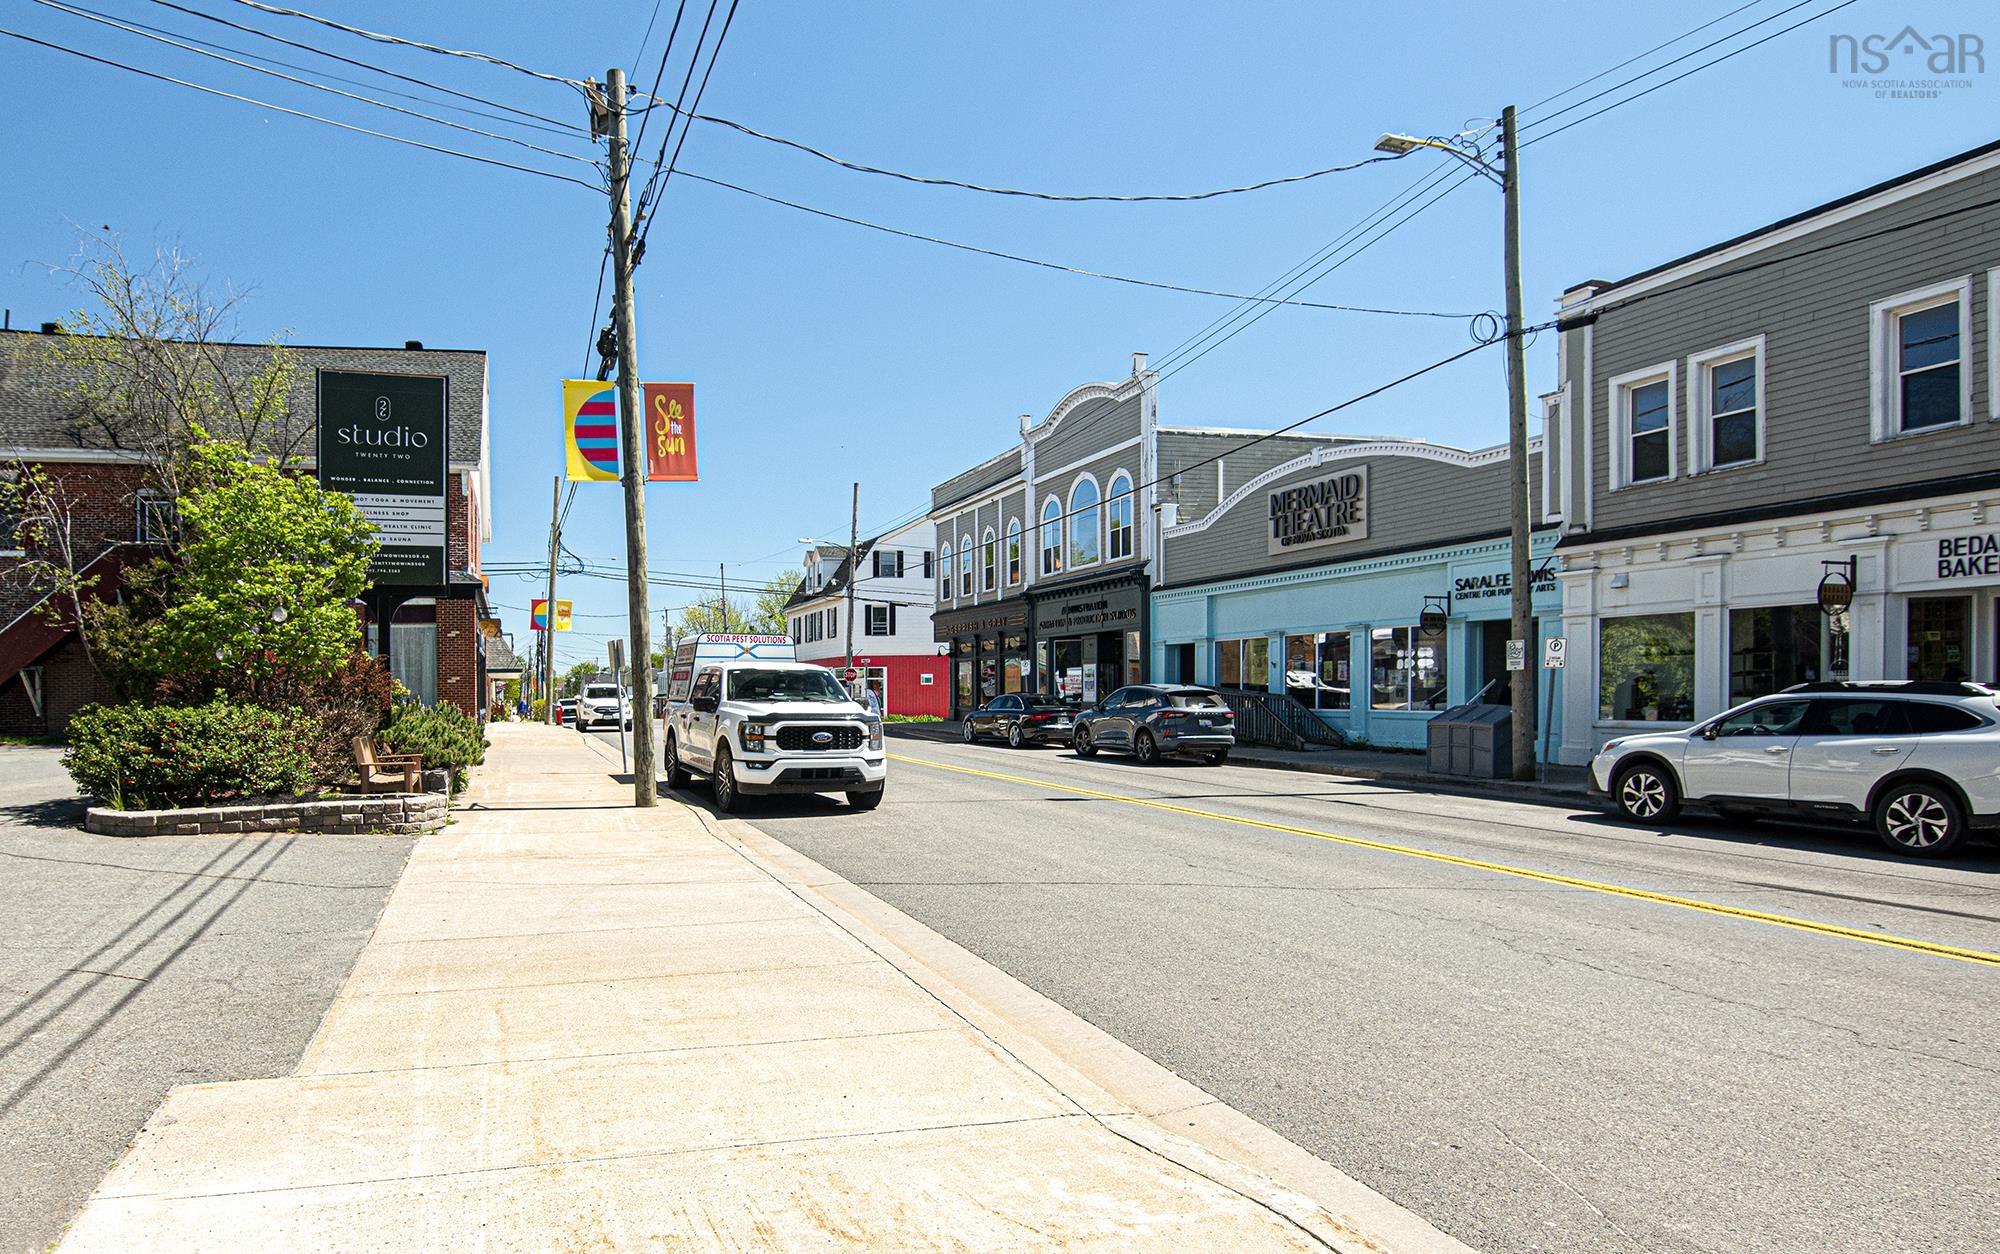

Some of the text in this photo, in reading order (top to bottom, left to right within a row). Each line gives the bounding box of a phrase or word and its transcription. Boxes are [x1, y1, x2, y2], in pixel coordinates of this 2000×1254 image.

[655, 394, 685, 435] See
[337, 424, 428, 448] studio
[670, 420, 682, 435] the
[1270, 474, 1360, 517] MERMAID
[1269, 500, 1364, 539] THEATRE
[1938, 534, 2000, 559] BEDA
[1938, 555, 2000, 579] BAKE
[1455, 573, 1511, 592] SARALEE
[1455, 590, 1481, 600] CENTRE
[1482, 588, 1497, 598] FOR
[1535, 583, 1556, 592] ARTS
[706, 634, 787, 644] SCOTIA PEST SOLUTIONS
